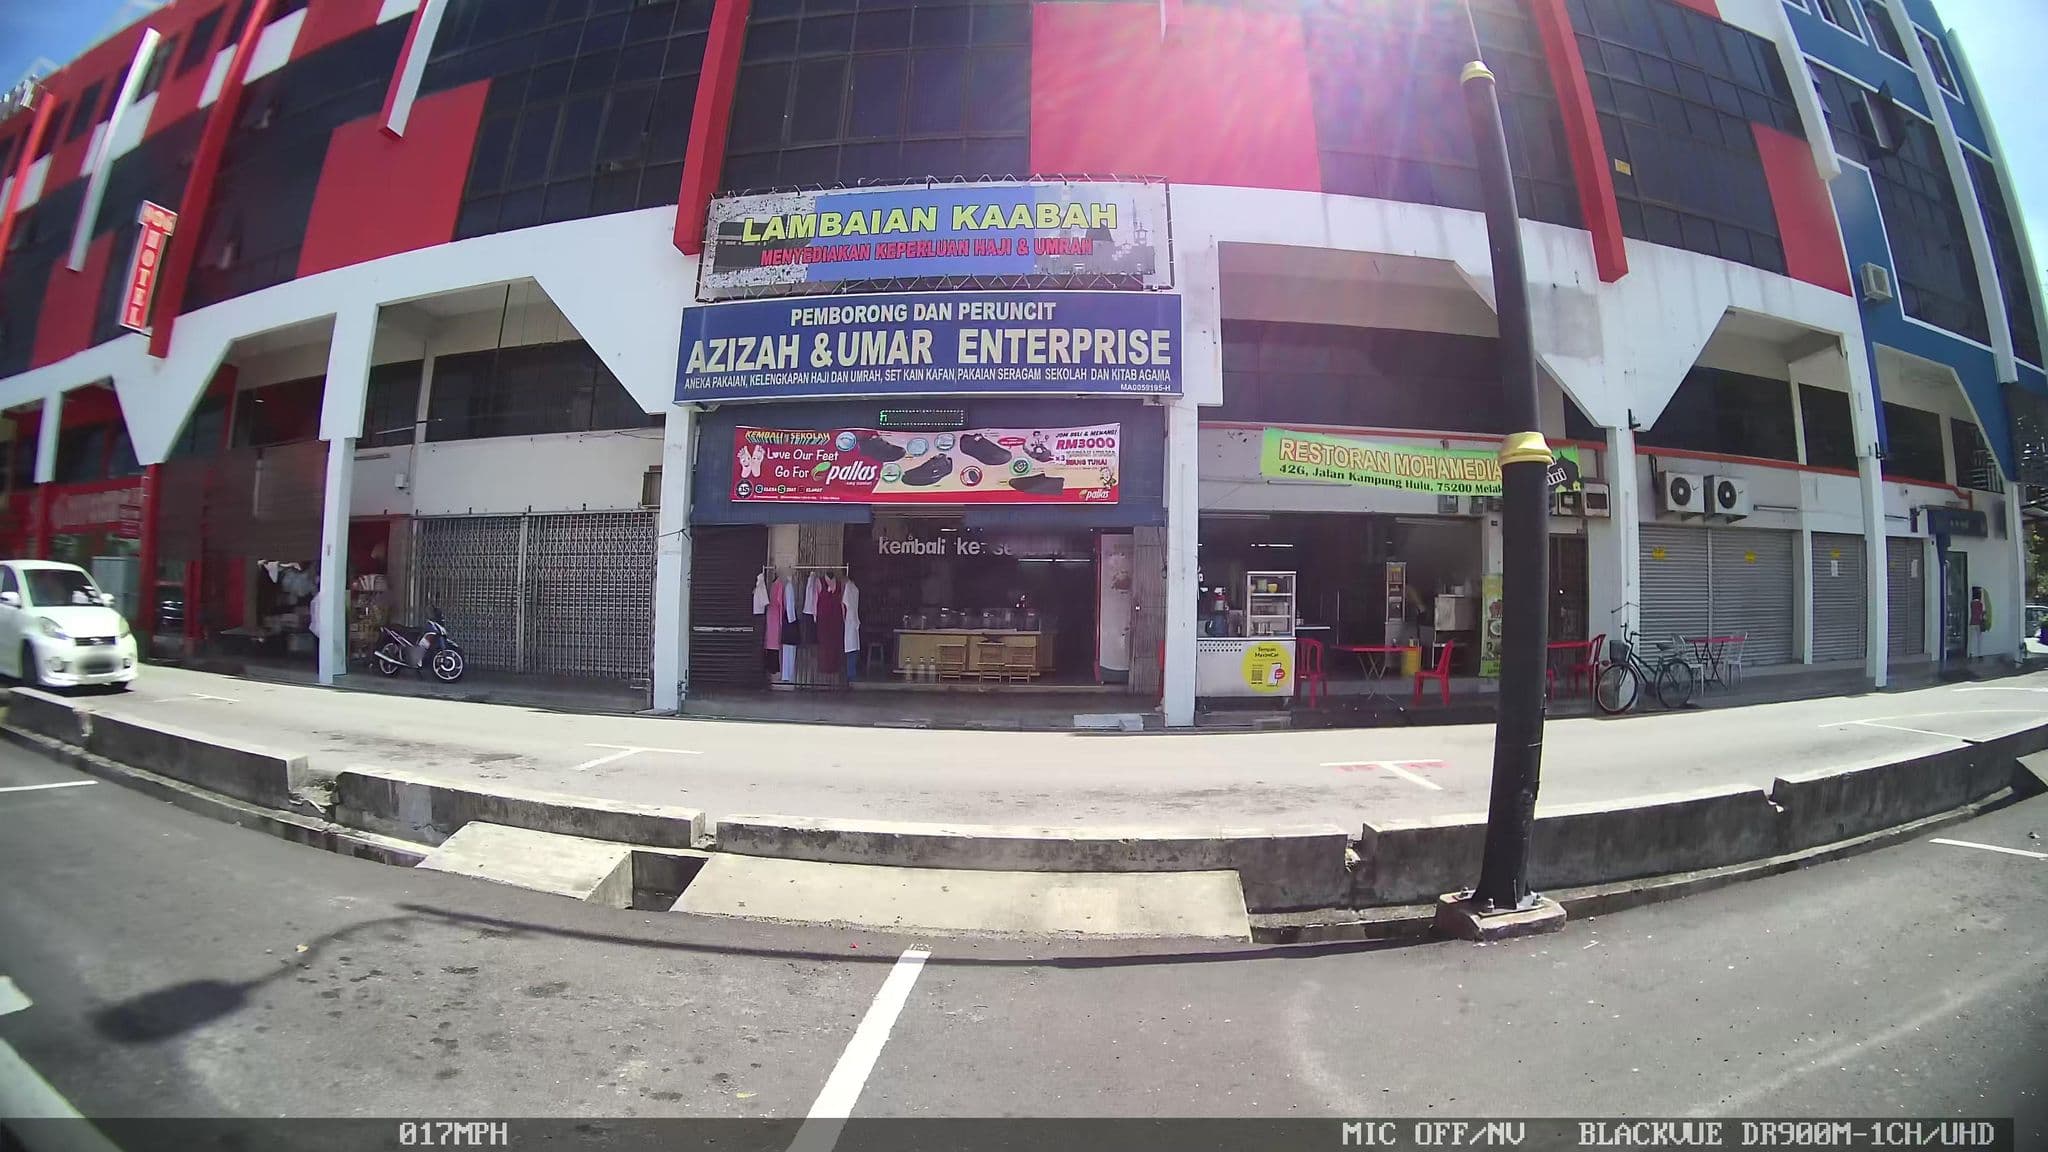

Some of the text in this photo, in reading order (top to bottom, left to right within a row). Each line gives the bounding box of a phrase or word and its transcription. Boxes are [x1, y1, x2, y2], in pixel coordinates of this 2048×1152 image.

[741, 202, 1118, 242] LAMBAIAN KAABAH
[760, 236, 1093, 266] MENYEDIAKAN KEPERLUAN HAJI & UMRAH
[791, 301, 1057, 327] PEMBORONG DAN PERUNCIT
[685, 334, 798, 374] AZIZAH
[958, 327, 1171, 366] ENTERPRISE
[685, 376, 711, 390] ANEKA
[712, 376, 748, 389] PAKAIAN,
[750, 371, 809, 386] KELENGKAPAN
[811, 371, 829, 384] HAJI
[831, 371, 849, 383] DAN
[850, 369, 883, 383] UMRAH,
[885, 368, 901, 381] SET
[903, 368, 924, 380] KAIN
[958, 368, 996, 381] PAKAIAN
[997, 367, 1041, 380] SERAGAM
[1045, 367, 1087, 380] SEKOLAH
[1091, 367, 1109, 381] DAN
[1111, 368, 1137, 381] KITAB
[1138, 369, 1171, 382] AGAMA
[745, 430, 784, 444] KEMBALI
[790, 432, 830, 445] SEKOLAH
[1056, 437, 1115, 450] RM3000
[793, 448, 813, 461] Our
[816, 449, 839, 461] Feet
[1279, 438, 1391, 472] RESTORAN
[775, 461, 878, 484] Go For pallas
[1312, 467, 1345, 481] Jalan
[1348, 471, 1402, 489] Kampung
[1437, 482, 1472, 493] 75200
[1086, 489, 1109, 500] pallas
[878, 536, 946, 555] kembali
